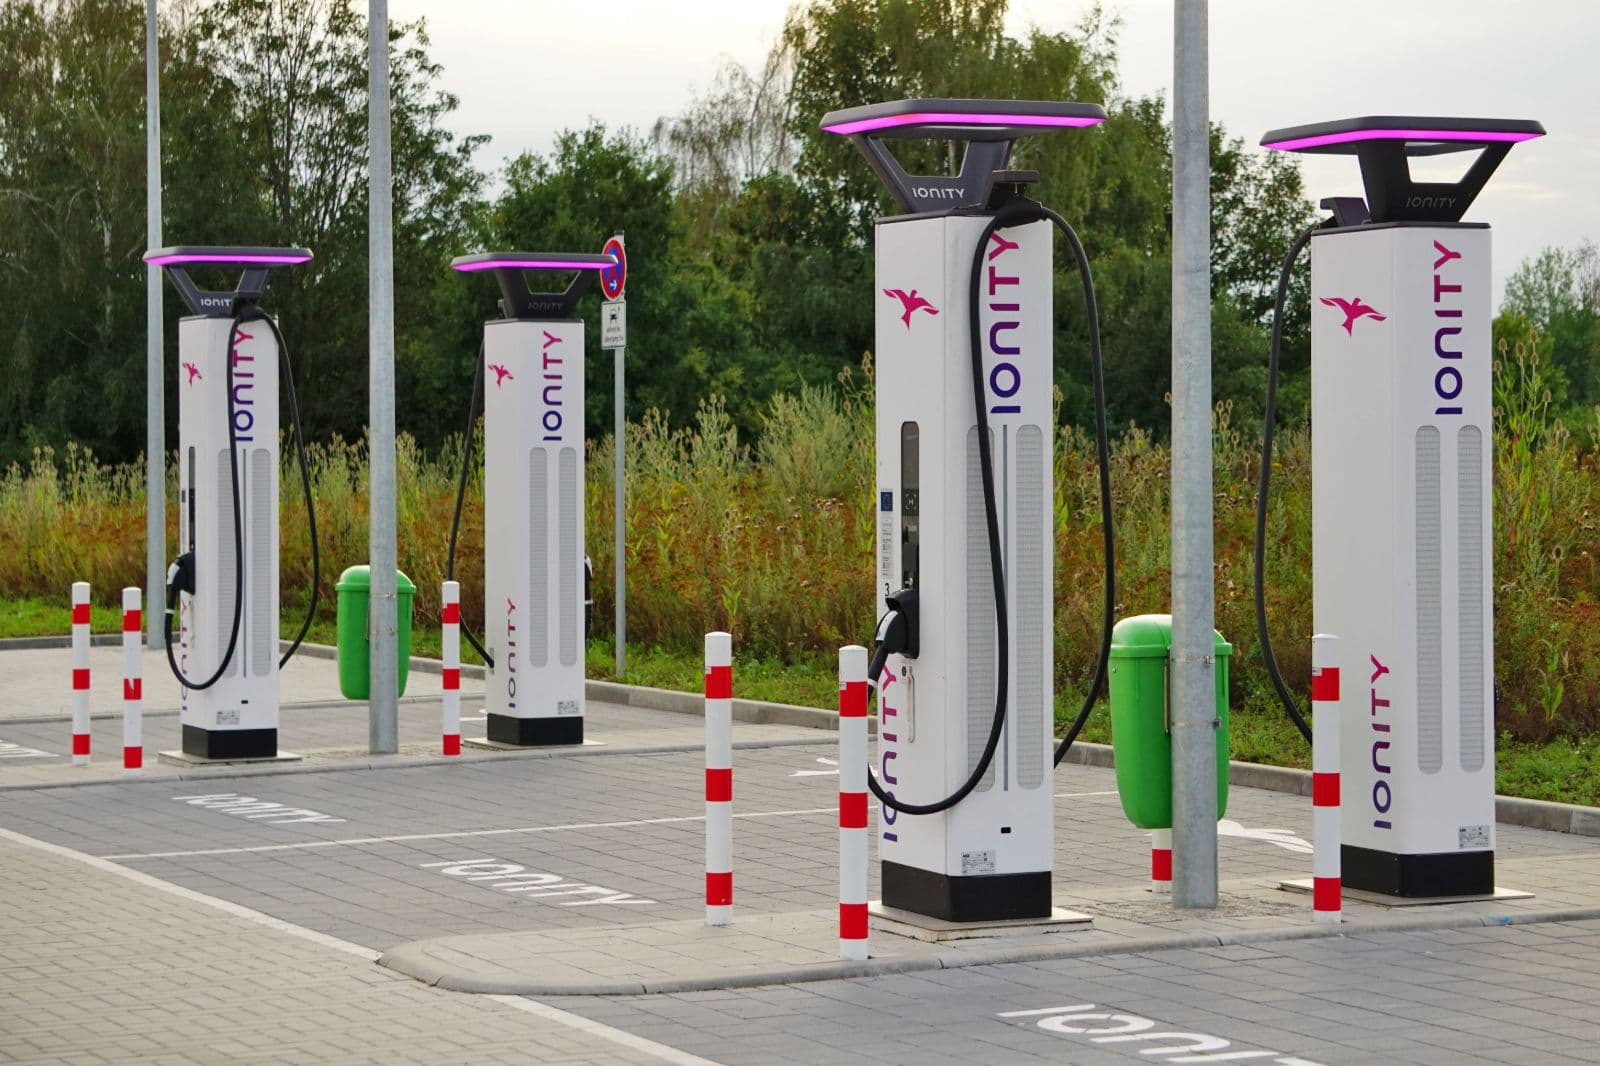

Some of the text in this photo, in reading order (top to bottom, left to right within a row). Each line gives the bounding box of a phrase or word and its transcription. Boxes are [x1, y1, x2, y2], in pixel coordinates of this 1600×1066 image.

[912, 186, 965, 200] IONITY
[1405, 194, 1456, 209] IONITY
[200, 298, 231, 307] IONIT
[527, 302, 563, 311] IONITY
[988, 231, 1021, 414] IONITY
[1433, 239, 1463, 415] IONITY
[232, 328, 255, 442] IONITY
[542, 330, 563, 441] IONITY
[507, 598, 516, 708] IONITY
[882, 664, 898, 843] IONITY
[1370, 653, 1392, 829] IONITY
[419, 858, 657, 906] IONITY
[995, 1003, 1328, 1066] IONI
